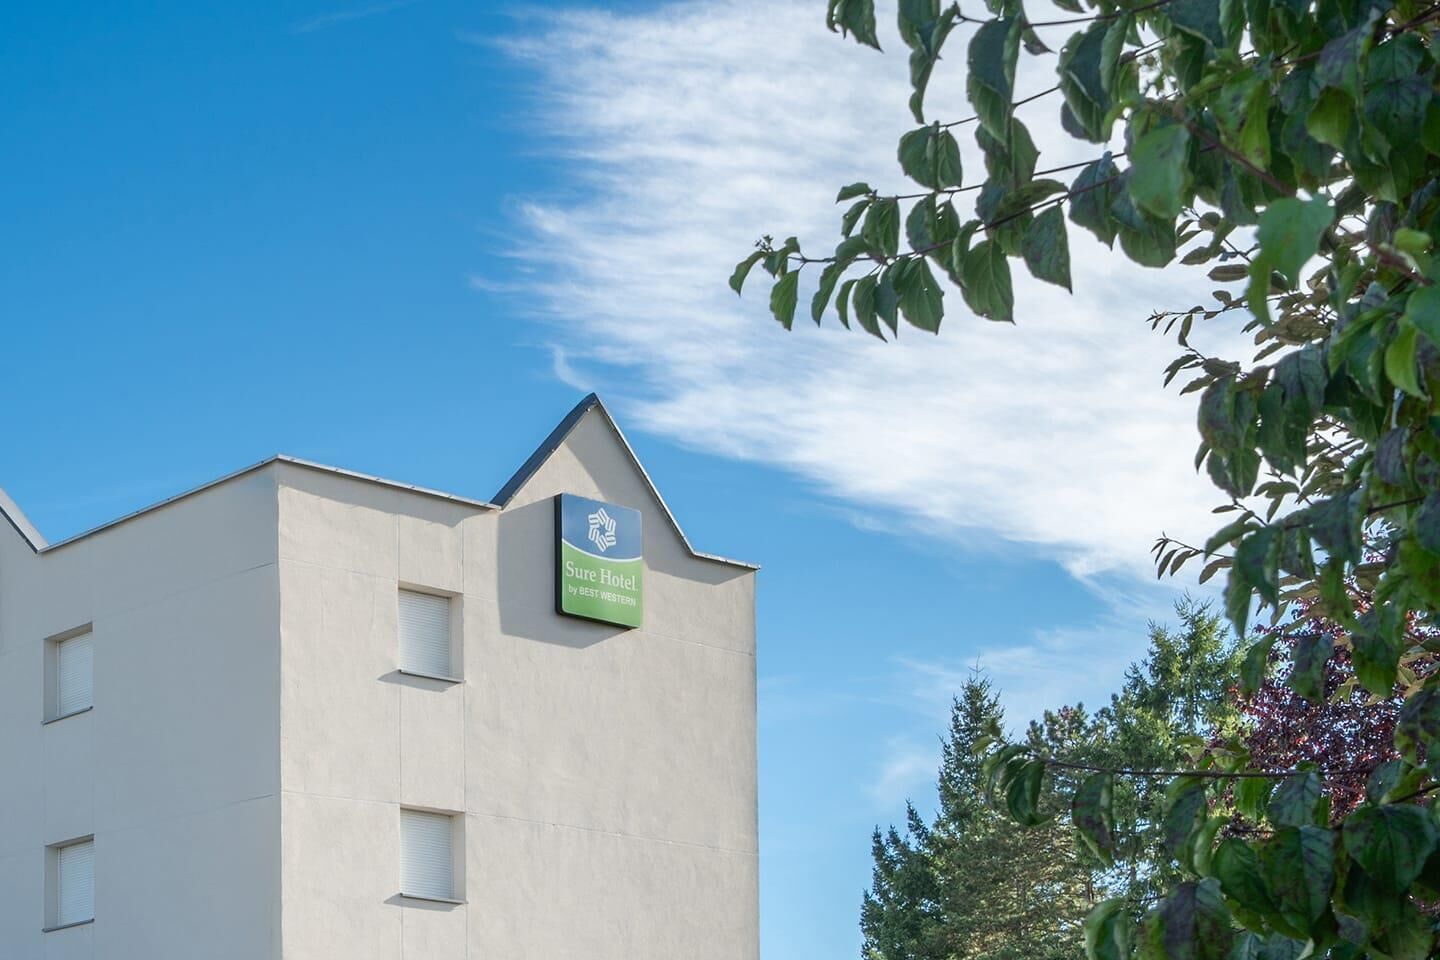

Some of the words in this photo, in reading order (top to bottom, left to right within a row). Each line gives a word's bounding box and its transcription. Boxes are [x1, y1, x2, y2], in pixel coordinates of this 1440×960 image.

[566, 560, 597, 582] Sure
[600, 568, 636, 592] Hotel
[568, 584, 578, 596] by
[579, 586, 599, 599] BEST
[601, 591, 637, 607] WESTERN
